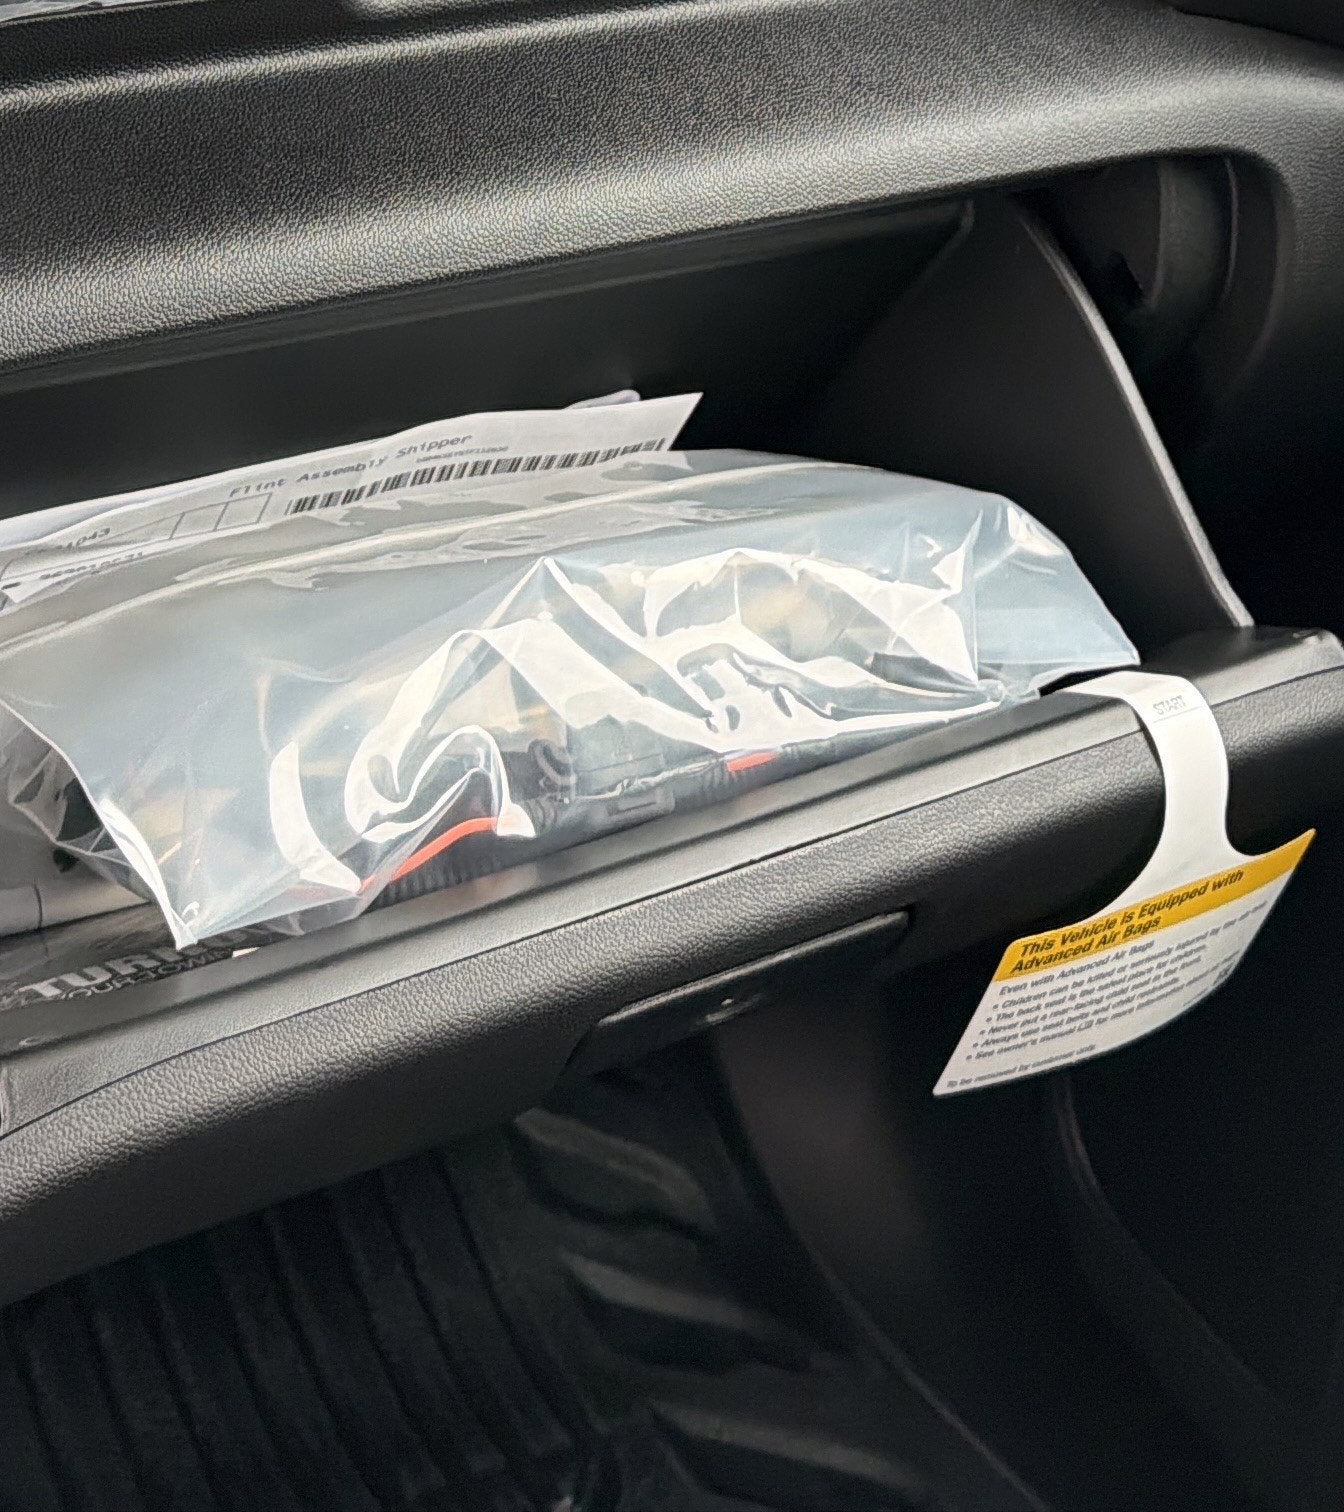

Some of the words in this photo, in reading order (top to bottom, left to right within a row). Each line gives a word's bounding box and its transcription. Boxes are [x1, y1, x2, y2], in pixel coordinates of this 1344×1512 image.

[229, 478, 287, 498] Flint
[296, 455, 388, 484] Assembly
[396, 434, 473, 459] Shipper
[1019, 940, 1054, 957] This
[1060, 919, 1116, 946] Vehicle
[1137, 879, 1209, 920] Equipped
[1210, 870, 1245, 891] with
[999, 982, 1028, 996] Even
[1030, 974, 1054, 987] with
[1056, 956, 1110, 979] Advanced
[1110, 952, 1126, 963] Air
[1128, 940, 1155, 956] Bags
[1010, 937, 1093, 974] Advanced
[1094, 934, 1117, 949] Air
[1122, 914, 1162, 940] Bags
[987, 1022, 1019, 1035] Never
[1020, 1016, 1039, 1028] put
[1105, 985, 1129, 1003] child
[1129, 978, 1151, 992] seat
[1162, 965, 1179, 978] the
[996, 1010, 1014, 1021] The
[1016, 1004, 1041, 1017] back
[1044, 997, 1066, 1009] seat
[1068, 993, 1076, 1001] is
[1079, 987, 1096, 998] the
[1156, 960, 1170, 970] for
[1002, 992, 1048, 1009] Children
[1049, 984, 1069, 996] can
[1071, 979, 1085, 989] be
[1086, 968, 1115, 984] killed
[1117, 964, 1127, 974] or
[975, 1050, 994, 1060] See
[996, 1039, 1038, 1055] owner's
[1039, 1027, 1075, 1042] manual
[1095, 1017, 1110, 1026] for
[980, 1032, 1019, 1048] Always
[1021, 1027, 1040, 1038] use
[1041, 1020, 1065, 1032] seat
[1066, 1010, 1090, 1025] belts
[1092, 1004, 1111, 1016] and
[1112, 995, 1135, 1010] child
